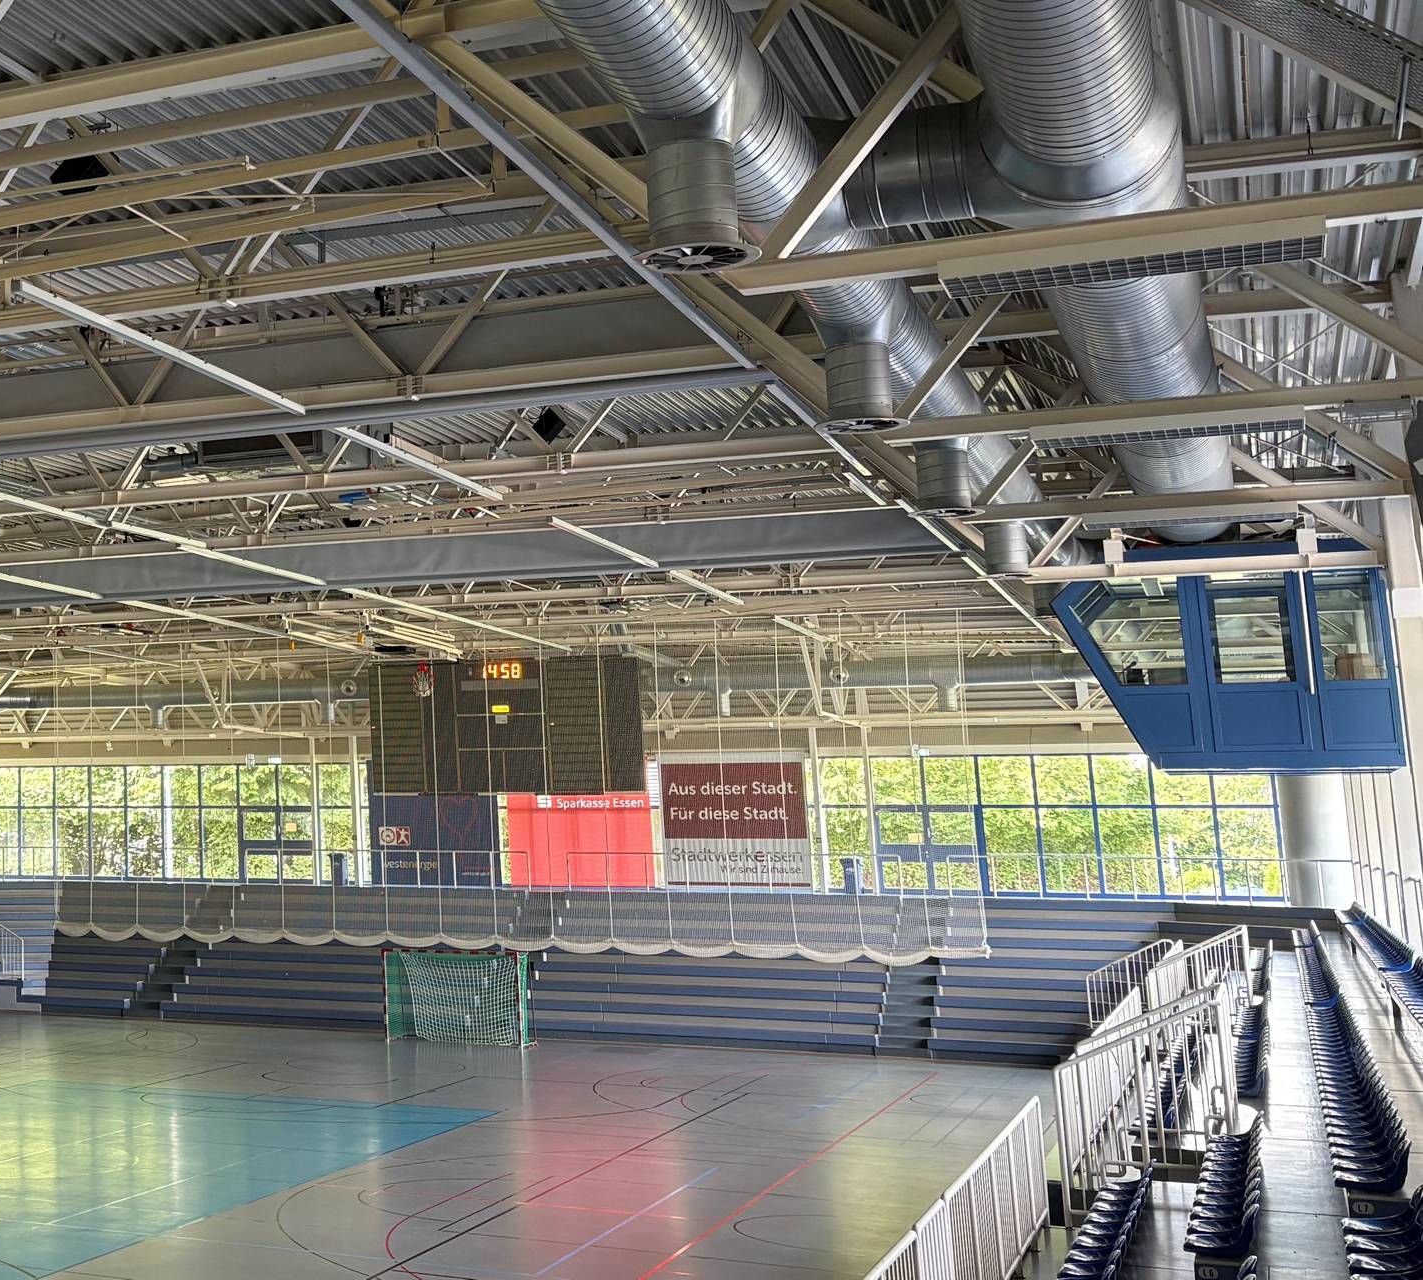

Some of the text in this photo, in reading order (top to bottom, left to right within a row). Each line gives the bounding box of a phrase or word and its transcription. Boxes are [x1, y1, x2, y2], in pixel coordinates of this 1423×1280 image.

[668, 781, 797, 795] Aus dieser Stadt.
[557, 797, 644, 810] Sparkasse Essen
[670, 806, 789, 820] Für diese Stadt.
[671, 847, 803, 863] Stadtwerkessen
[384, 860, 438, 871] estenrgie
[720, 865, 737, 873] Wir
[738, 864, 758, 874] sind
